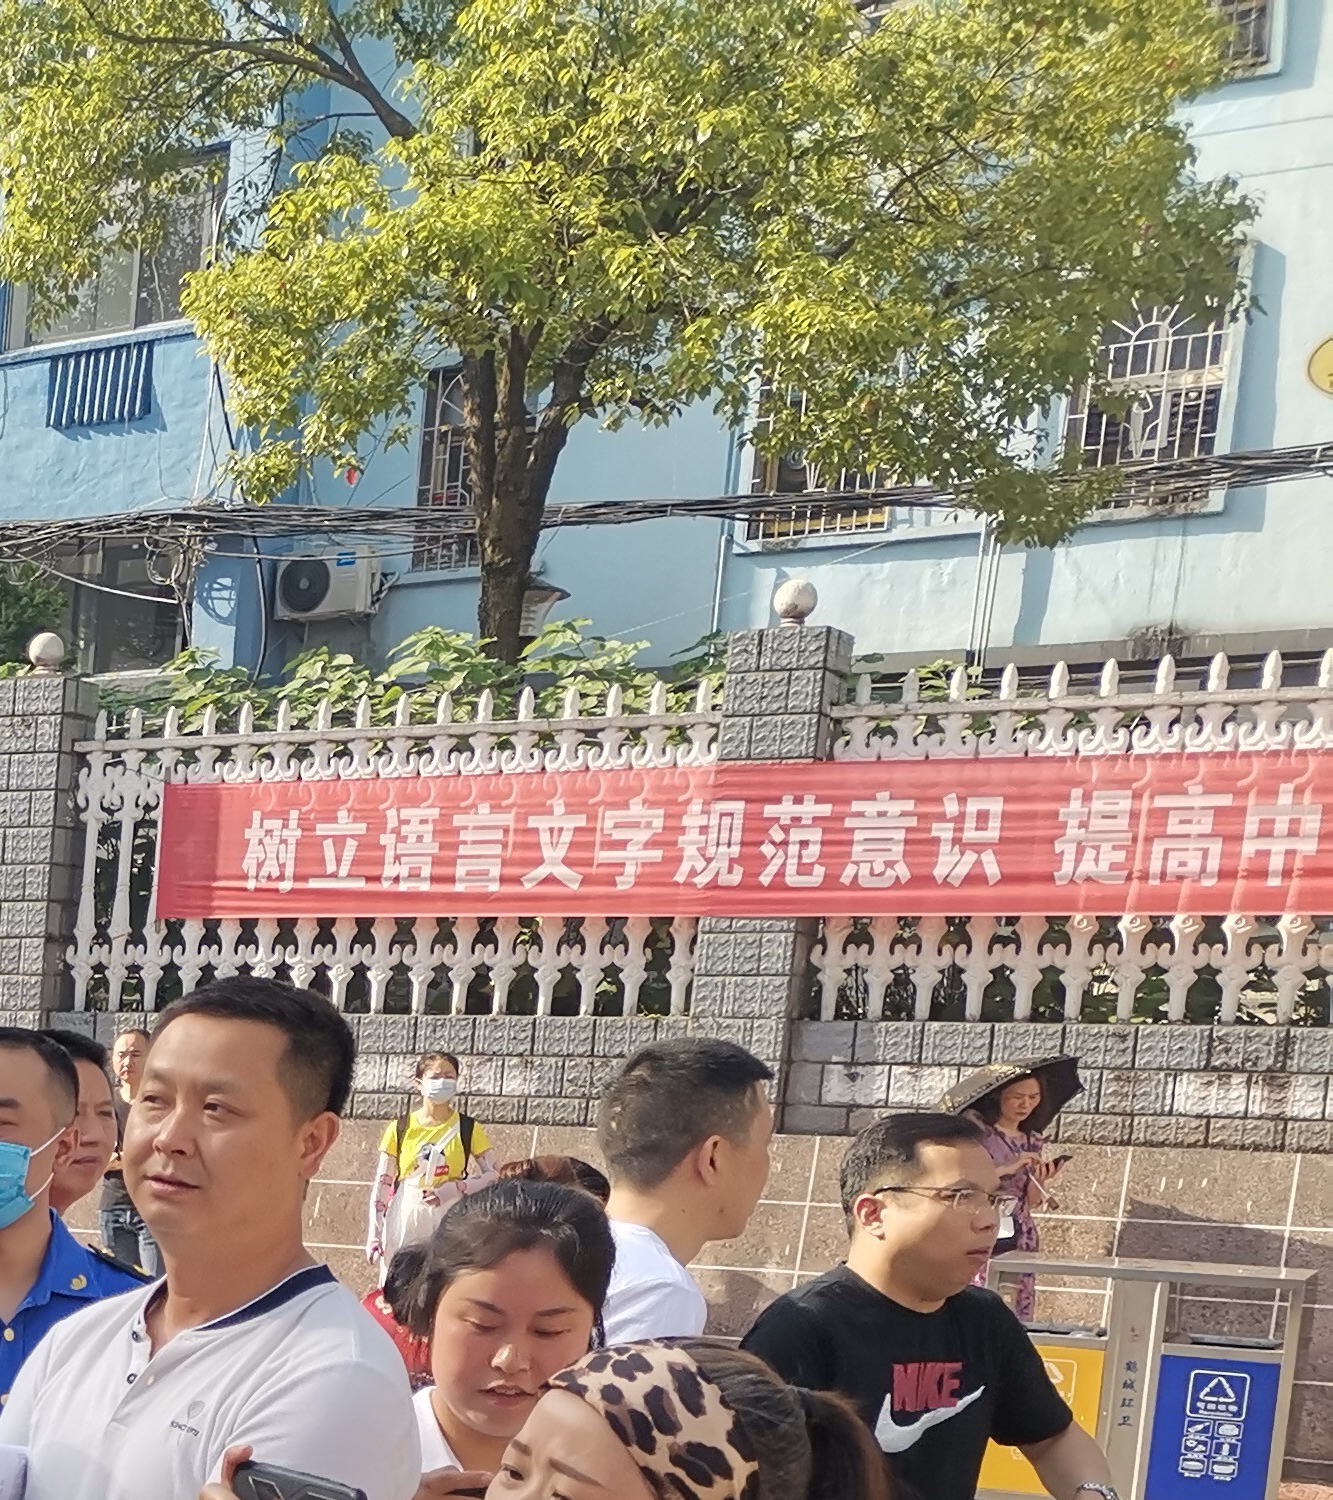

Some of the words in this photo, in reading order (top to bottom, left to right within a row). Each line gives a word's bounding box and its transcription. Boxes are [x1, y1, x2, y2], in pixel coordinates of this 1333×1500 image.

[241, 789, 1006, 893] 树立语言文字规范意识
[1052, 783, 1323, 888] 提高中
[893, 1362, 963, 1412] NIKE
